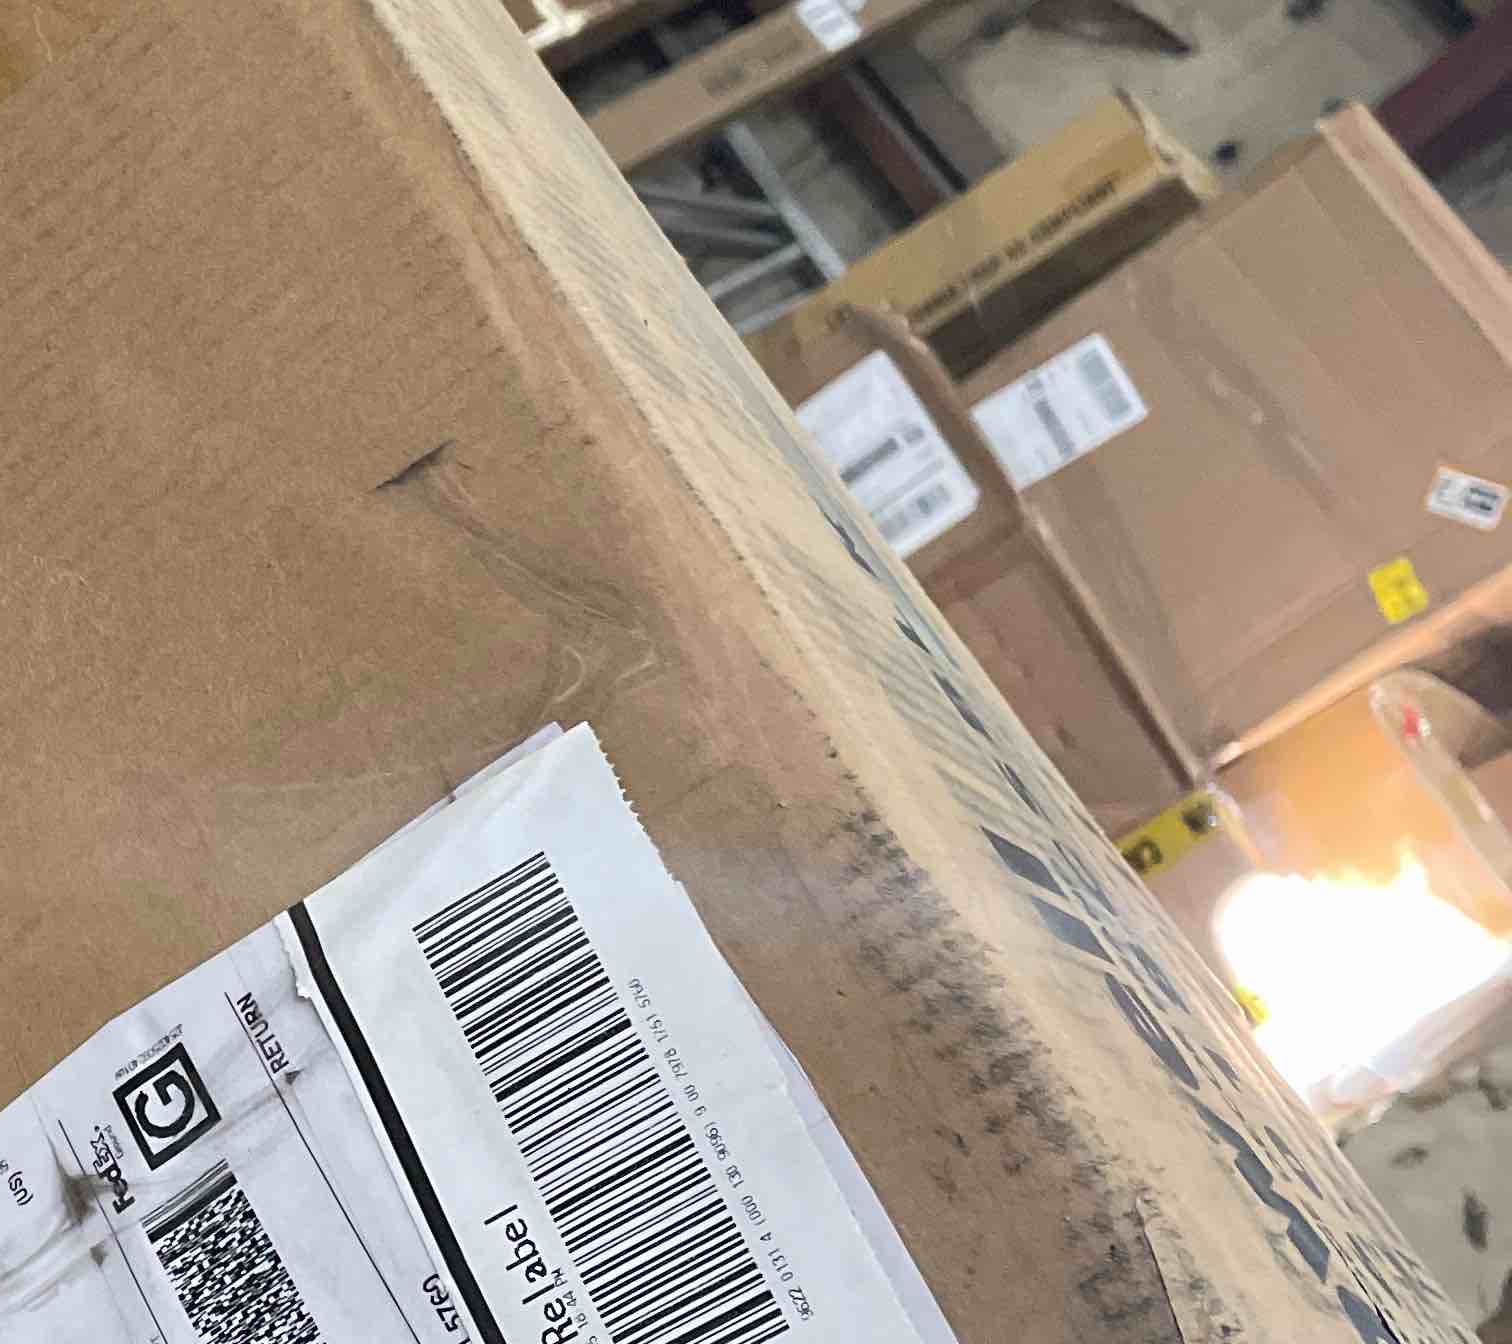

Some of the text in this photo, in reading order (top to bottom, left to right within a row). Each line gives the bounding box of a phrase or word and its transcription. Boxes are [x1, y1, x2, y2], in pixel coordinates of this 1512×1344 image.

[237, 991, 290, 1075] RETURN
[135, 1076, 196, 1138] G
[7, 1170, 34, 1207] (US)
[89, 1131, 136, 1215] FedEx
[759, 1231, 772, 1242] 4
[767, 1248, 794, 1283] 0131
[787, 1286, 814, 1321] 9622
